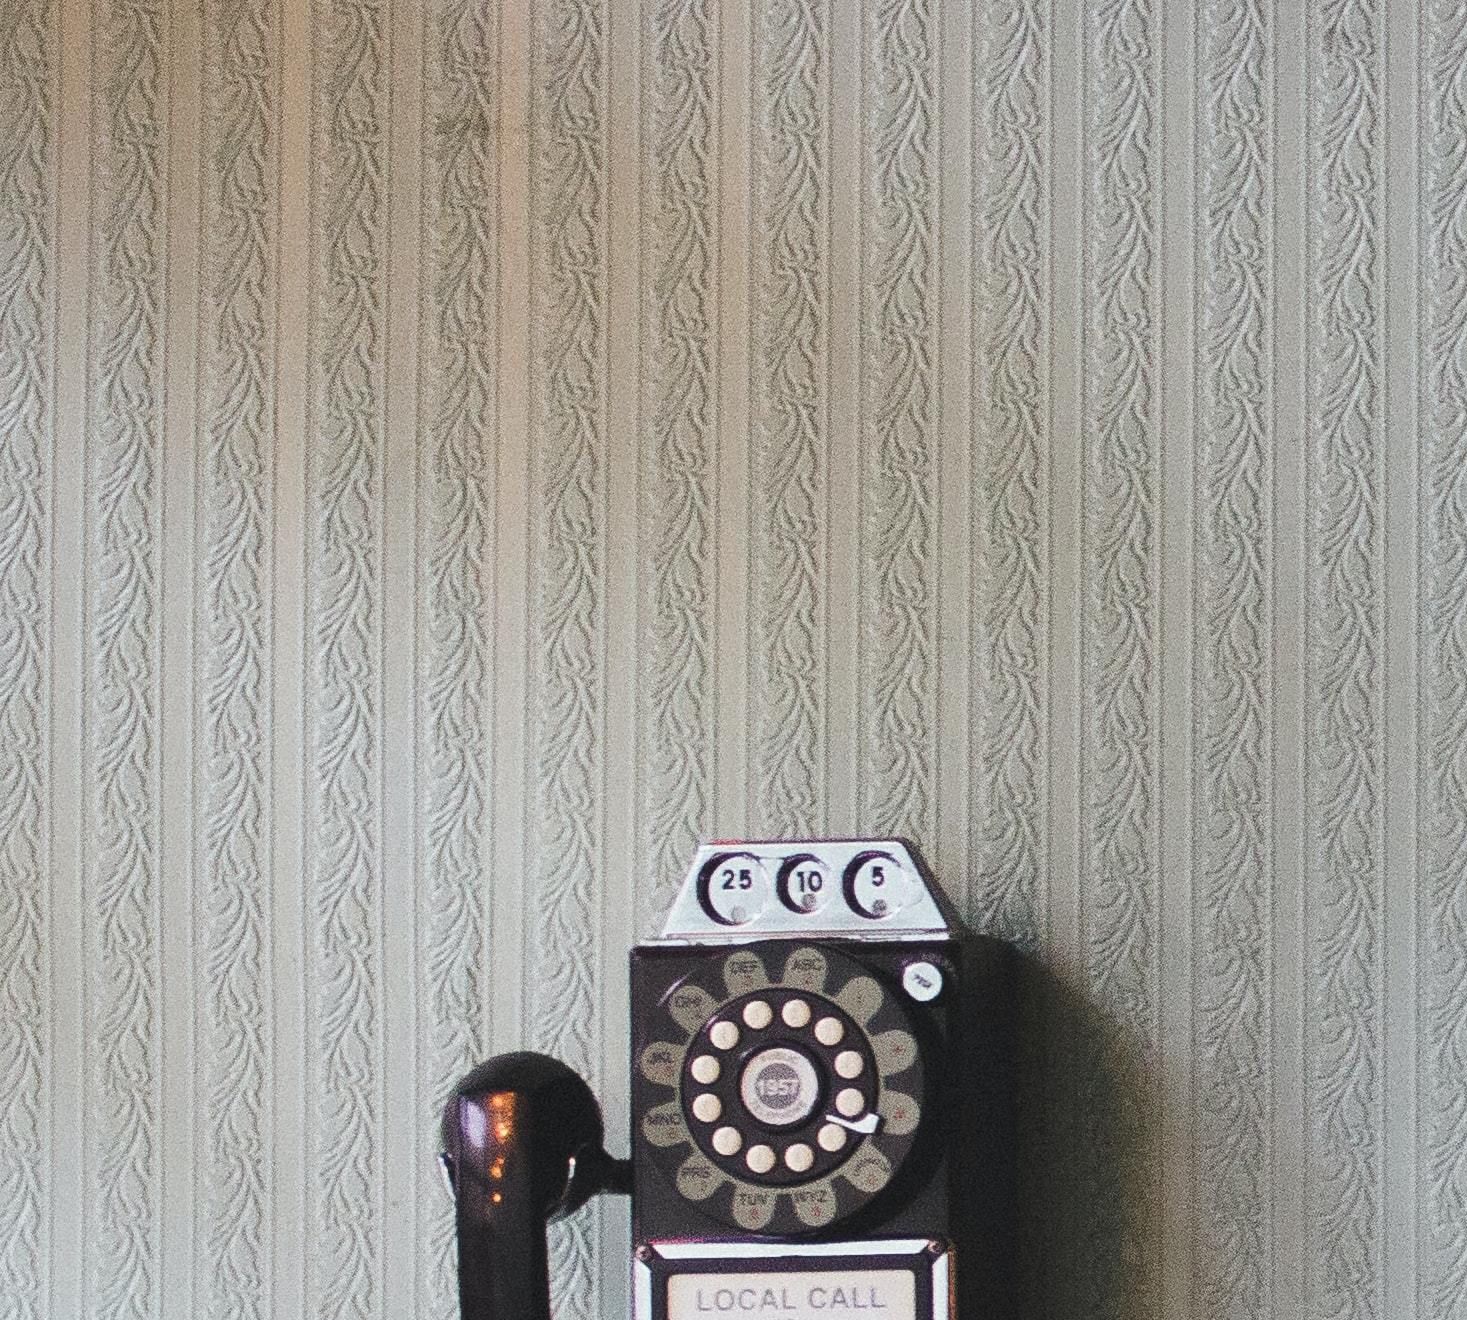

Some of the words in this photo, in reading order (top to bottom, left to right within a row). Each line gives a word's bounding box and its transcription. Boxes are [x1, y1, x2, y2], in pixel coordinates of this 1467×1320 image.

[722, 869, 752, 890] 25
[797, 871, 822, 892] 10
[872, 867, 885, 887] 5
[757, 1079, 799, 1096] 1957
[696, 1287, 796, 1312] LOCAL
[808, 1286, 886, 1309] CALL
